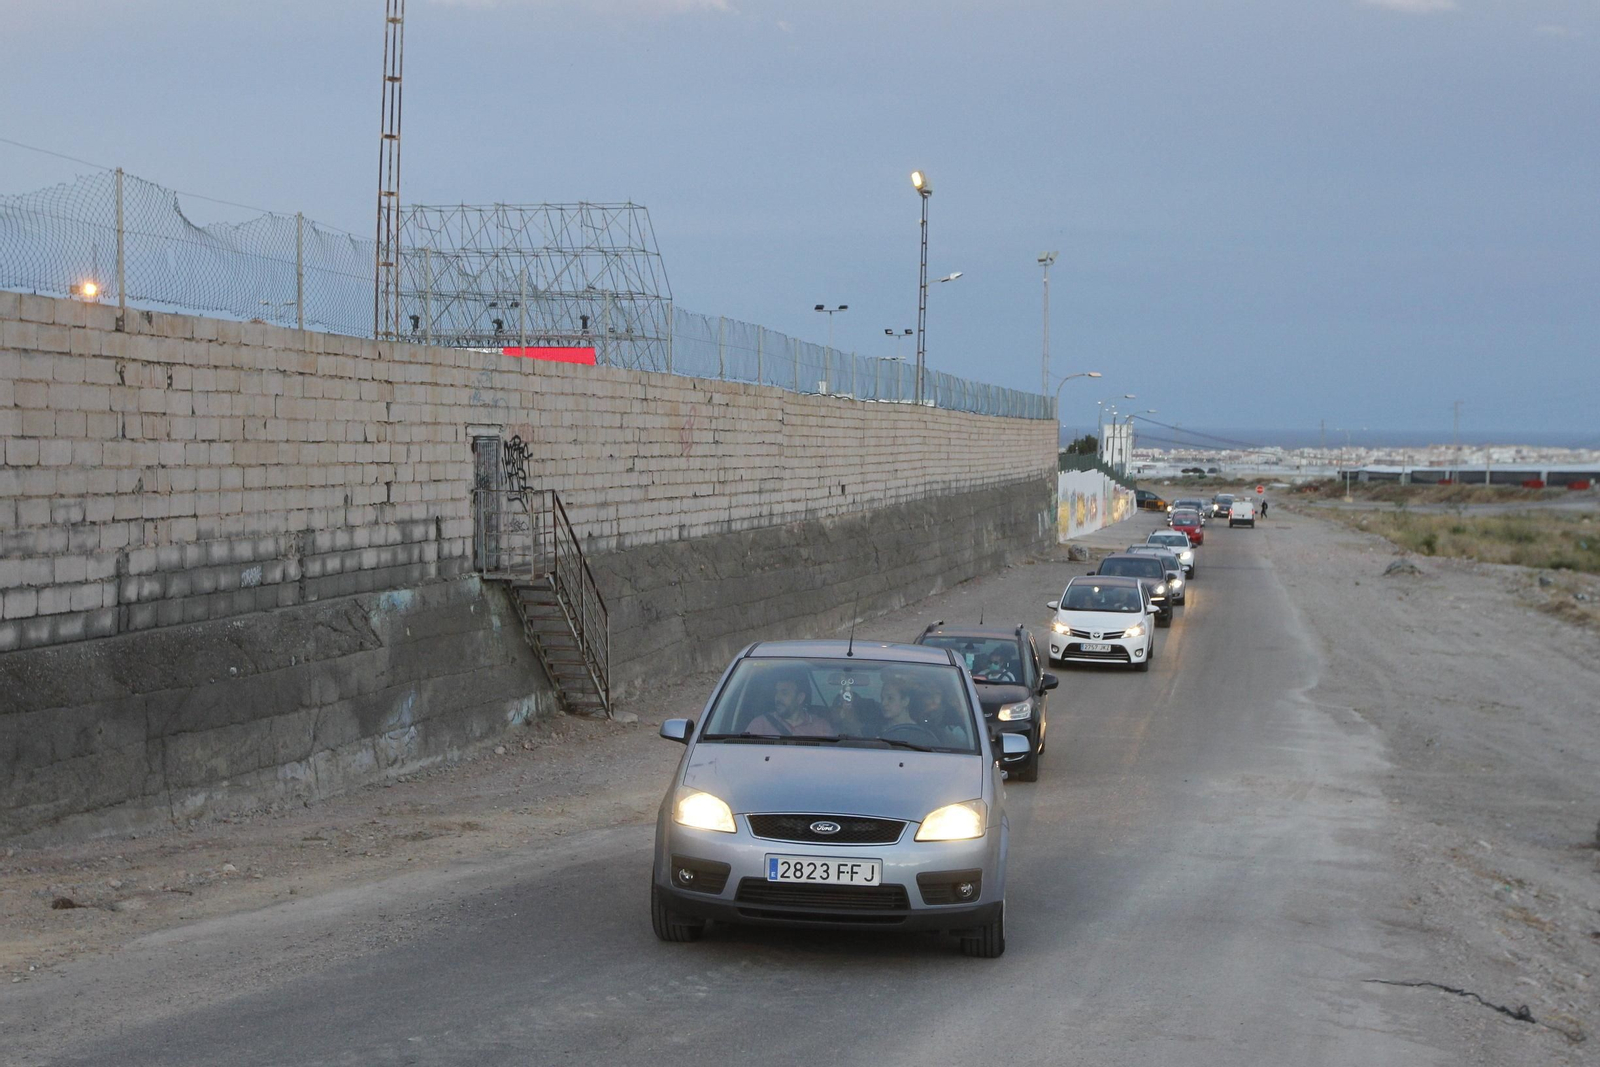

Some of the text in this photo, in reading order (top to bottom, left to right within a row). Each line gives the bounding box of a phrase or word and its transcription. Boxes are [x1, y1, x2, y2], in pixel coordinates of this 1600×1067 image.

[816, 823, 834, 831] Ford
[780, 861, 830, 880] 2823
[837, 864, 874, 882] FFJ
